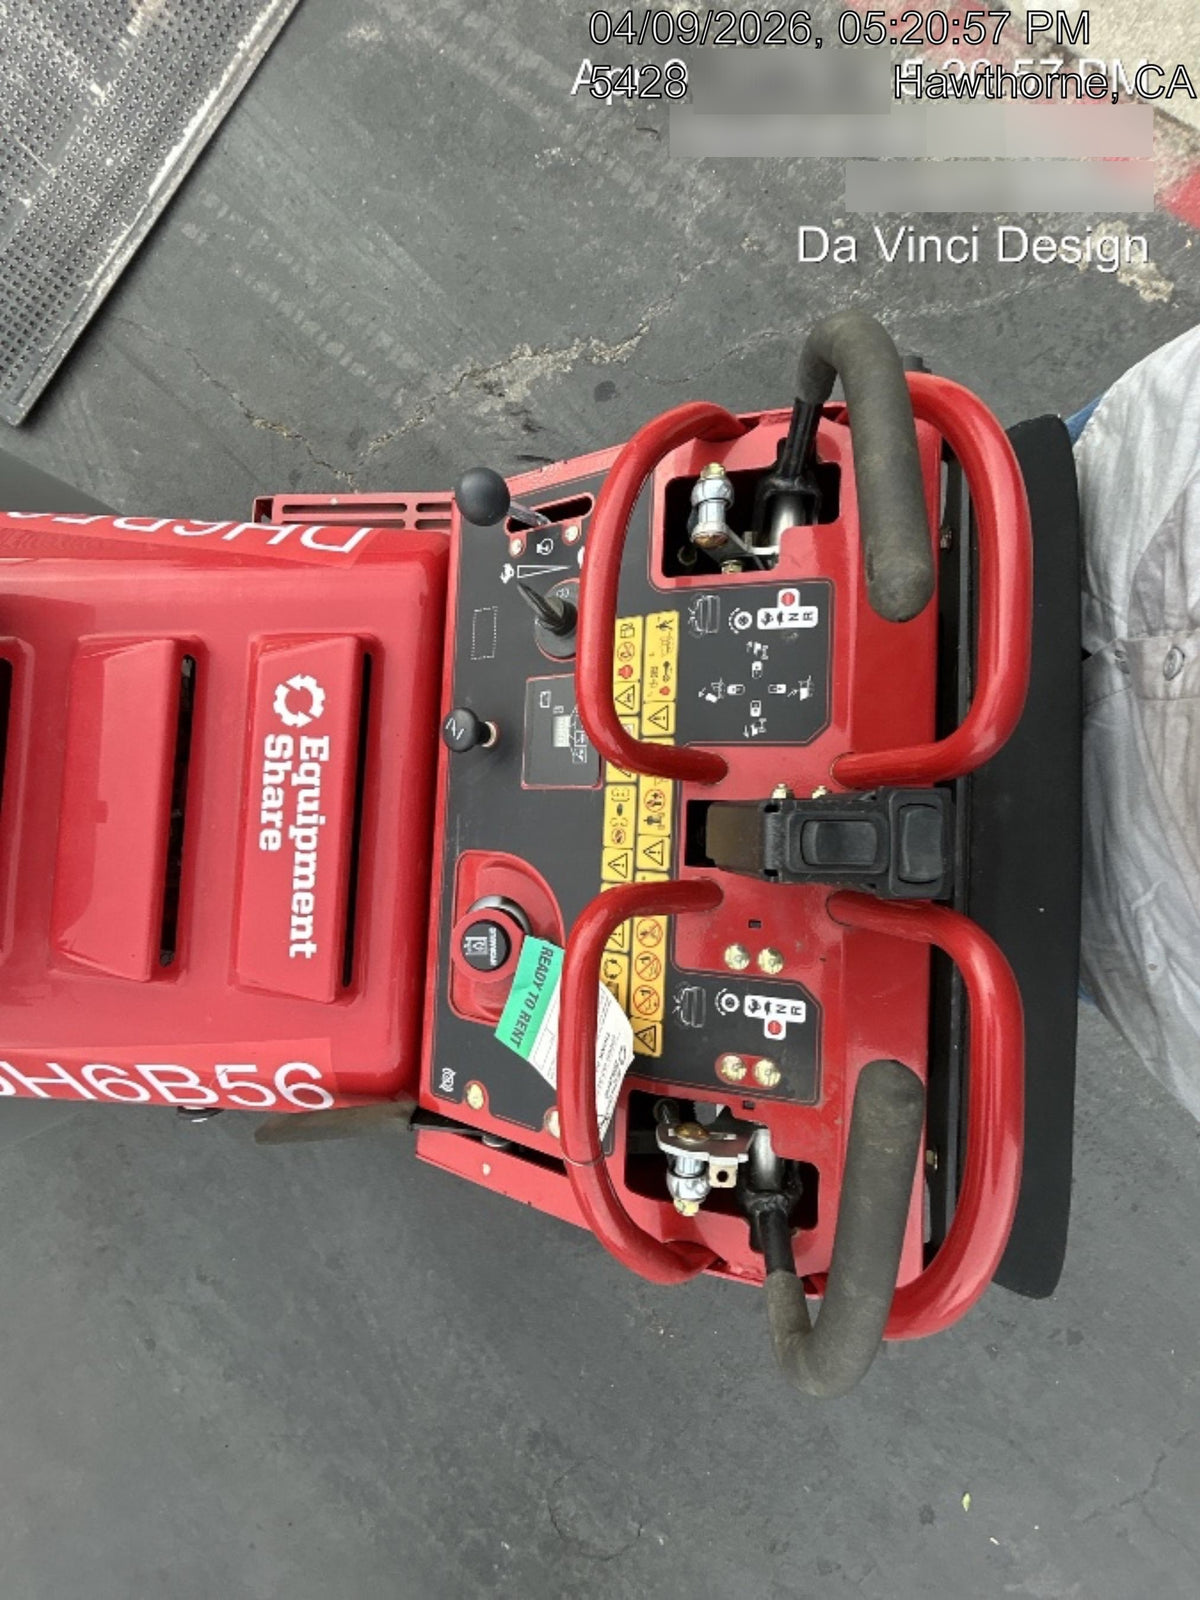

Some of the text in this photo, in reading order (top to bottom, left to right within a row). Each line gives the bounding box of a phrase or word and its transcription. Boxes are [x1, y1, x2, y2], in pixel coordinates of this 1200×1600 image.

[259, 733, 294, 852] Share
[288, 735, 330, 959] Equipment
[510, 945, 554, 1048] READY TO RENT
[0, 1061, 335, 1110] H6B56
